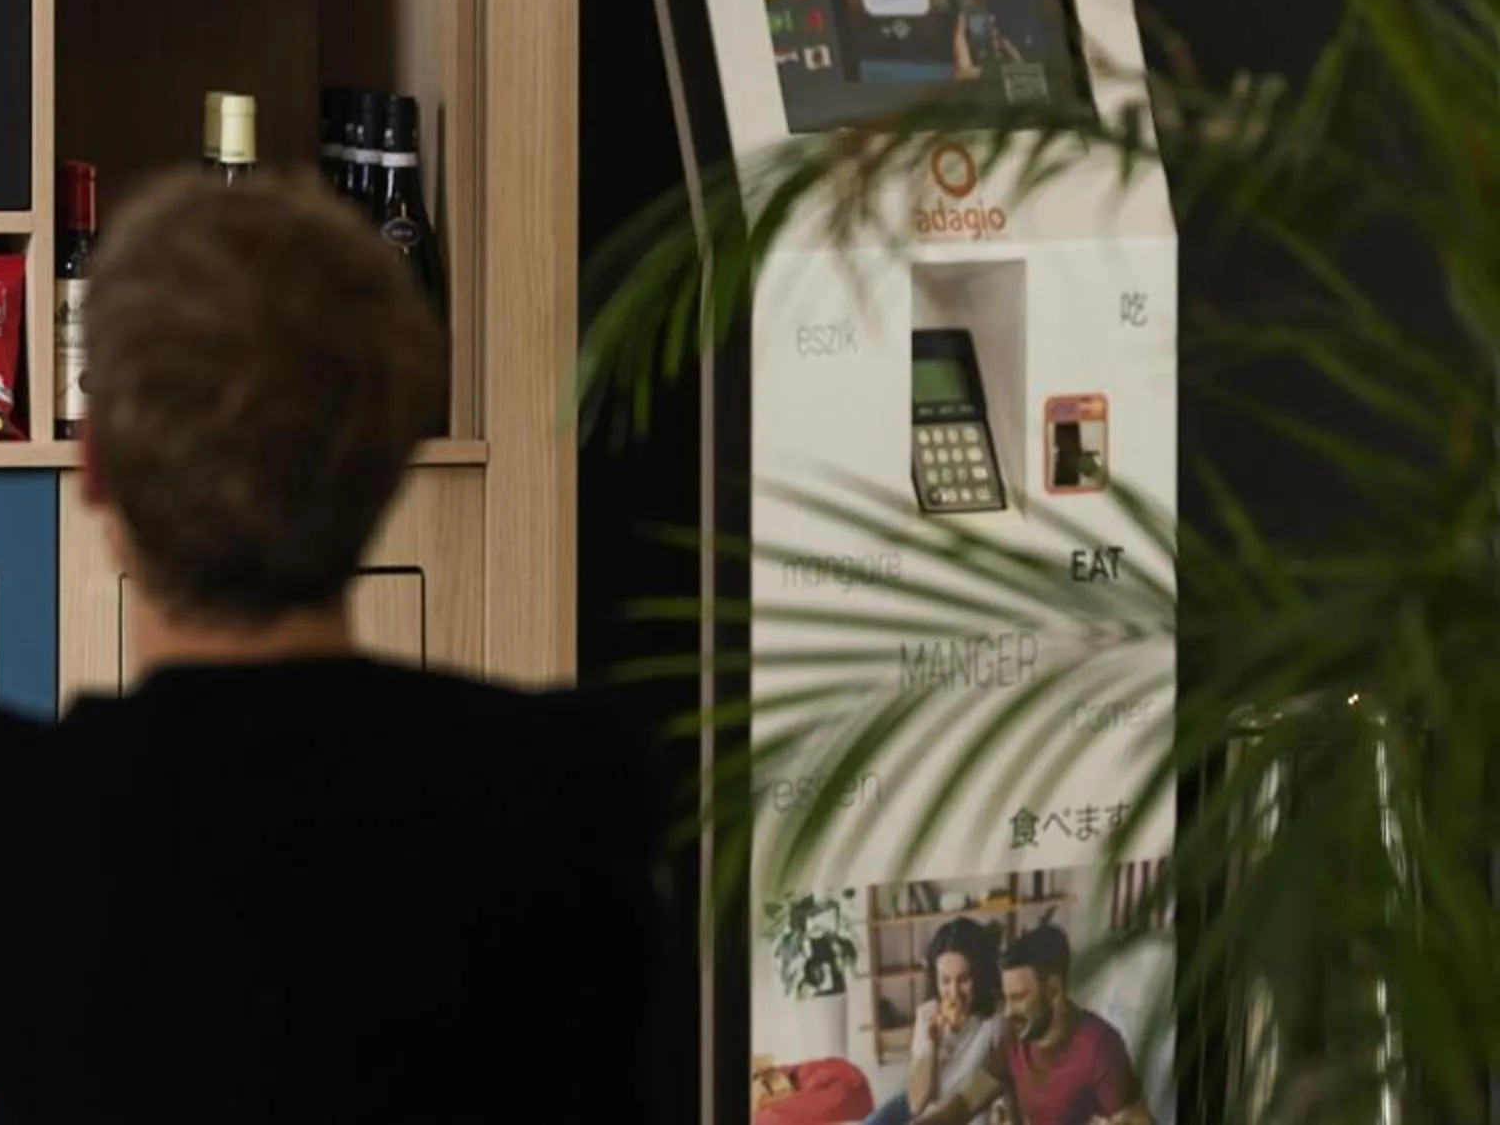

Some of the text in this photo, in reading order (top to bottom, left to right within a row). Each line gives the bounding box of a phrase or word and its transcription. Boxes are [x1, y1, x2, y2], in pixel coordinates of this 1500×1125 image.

[914, 198, 1008, 242] adagio
[1071, 546, 1125, 583] EAT
[899, 632, 1040, 690] MANGER
[773, 772, 883, 812] esen
[1010, 798, 1134, 850] 食べます
